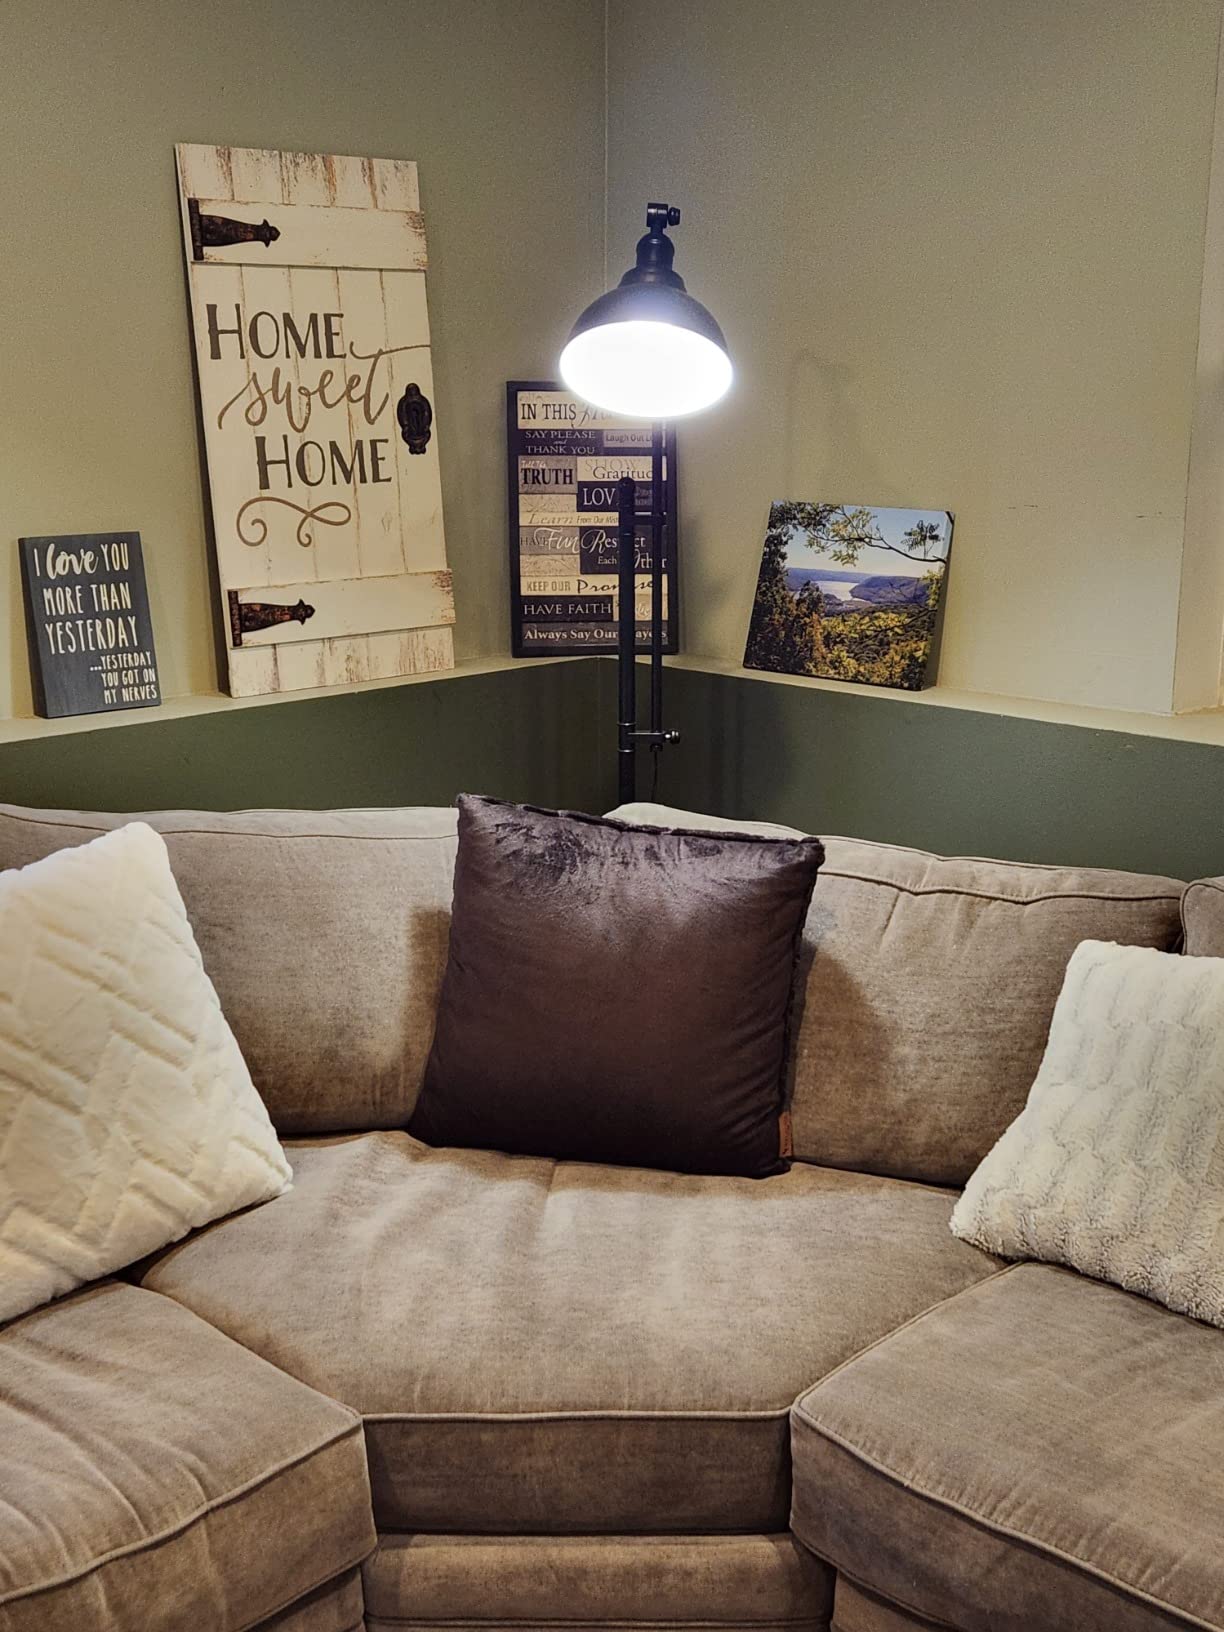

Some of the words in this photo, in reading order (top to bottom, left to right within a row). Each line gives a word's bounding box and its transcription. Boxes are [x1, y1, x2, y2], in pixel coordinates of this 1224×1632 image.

[206, 303, 346, 360] HOME
[218, 341, 431, 433] sweet
[521, 404, 536, 420] IN
[542, 403, 576, 420] THIS
[550, 431, 596, 439] PLEASE
[605, 433, 629, 442] Laugh
[630, 433, 645, 442] Out
[526, 446, 566, 454] THANK
[571, 446, 595, 454] YOU
[255, 434, 392, 490] HOME
[521, 468, 573, 485] TRUTH
[593, 466, 652, 479] Gratitu
[583, 488, 620, 506] LOV
[528, 514, 573, 524] Learn
[534, 527, 580, 553] Fun
[581, 529, 646, 555] Resct
[33, 548, 40, 577] I
[46, 543, 98, 580] love
[100, 542, 129, 572] YOU
[598, 556, 617, 564] Each
[527, 581, 549, 591] KEEP
[551, 581, 571, 590] OUR
[43, 585, 84, 616] MORE
[90, 582, 132, 612] THAN
[524, 604, 562, 615] HAVE
[569, 603, 611, 614] FAITH
[45, 616, 138, 655] YESTERDAY
[525, 629, 567, 643] Always
[571, 630, 591, 642] Say
[594, 629, 618, 639] Our
[101, 672, 119, 687] YOU
[122, 670, 140, 684] GOT
[143, 668, 155, 682] ON
[103, 689, 117, 704] MY
[123, 686, 158, 702] NERVES
